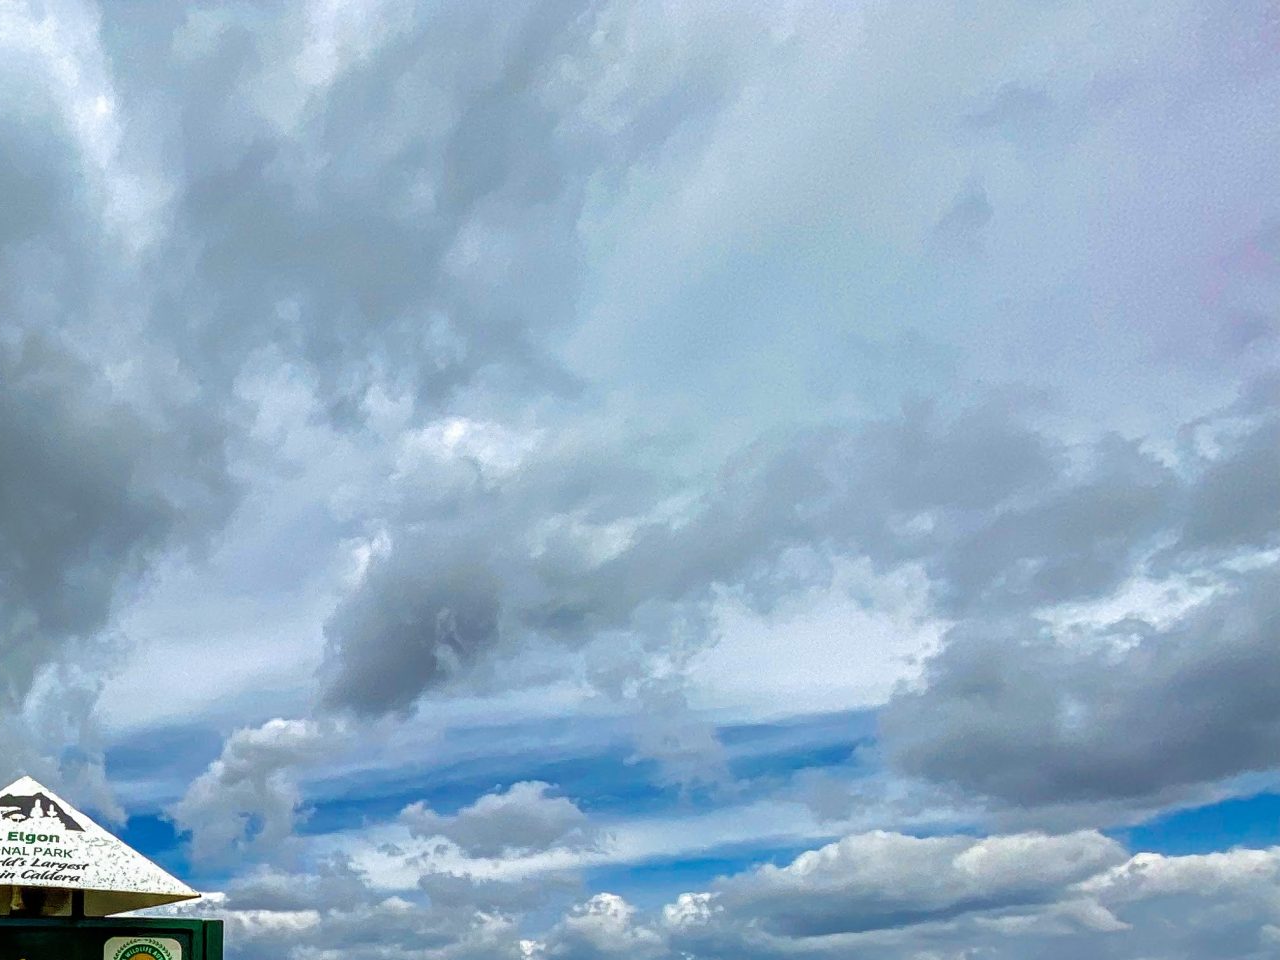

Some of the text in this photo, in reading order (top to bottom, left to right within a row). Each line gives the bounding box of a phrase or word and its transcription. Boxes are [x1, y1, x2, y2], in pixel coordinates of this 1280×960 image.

[7, 831, 60, 844] Elgon
[33, 847, 73, 858] PARK
[30, 858, 89, 871] Largest
